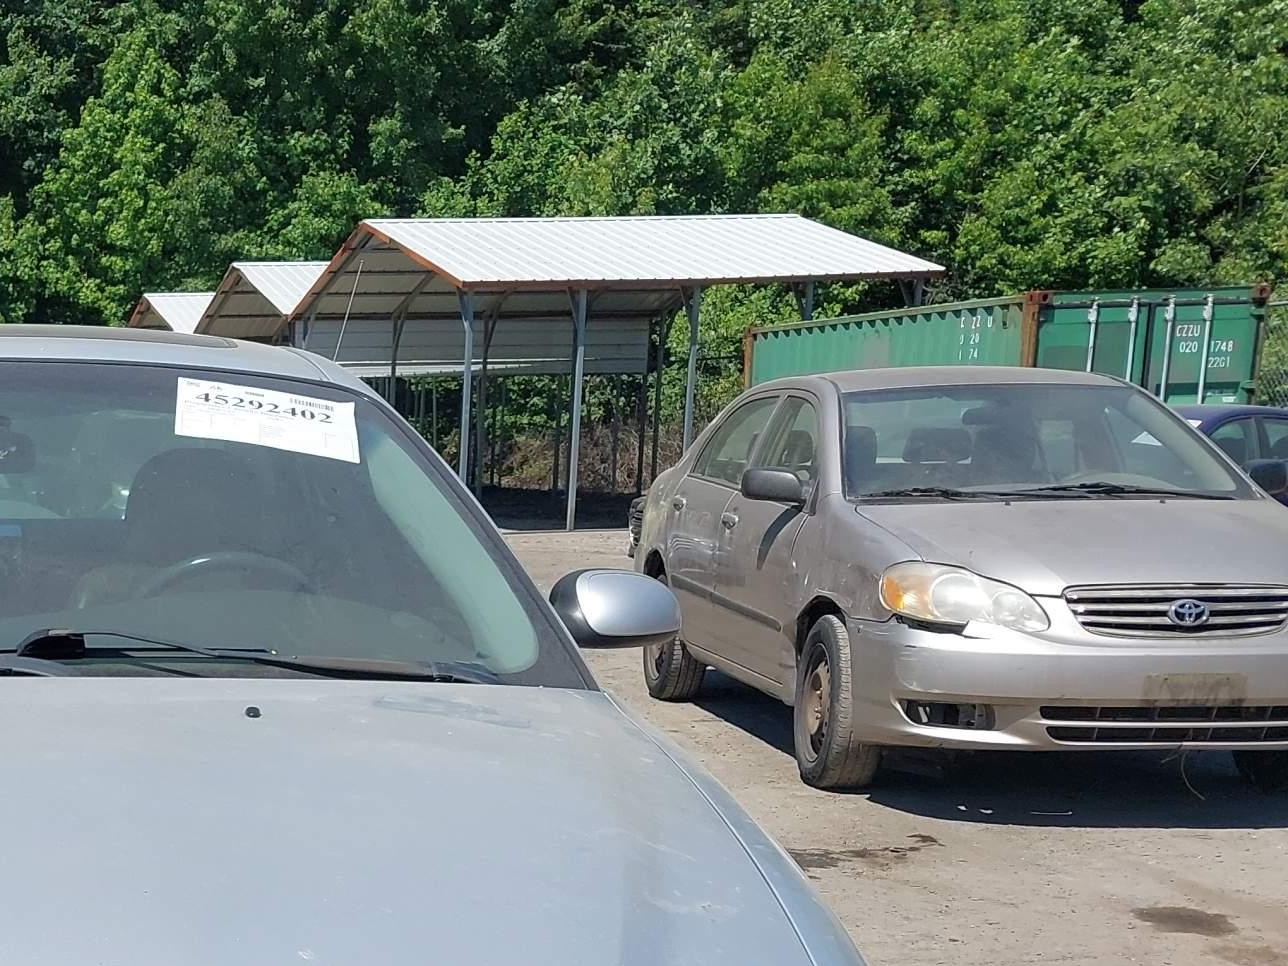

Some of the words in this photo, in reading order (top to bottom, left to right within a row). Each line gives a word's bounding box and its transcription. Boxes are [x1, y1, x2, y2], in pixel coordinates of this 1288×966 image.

[1176, 324, 1201, 337] CZZU
[1179, 341, 1199, 353] 020
[1207, 356, 1231, 368] 22G1
[195, 392, 333, 424] 45292402
